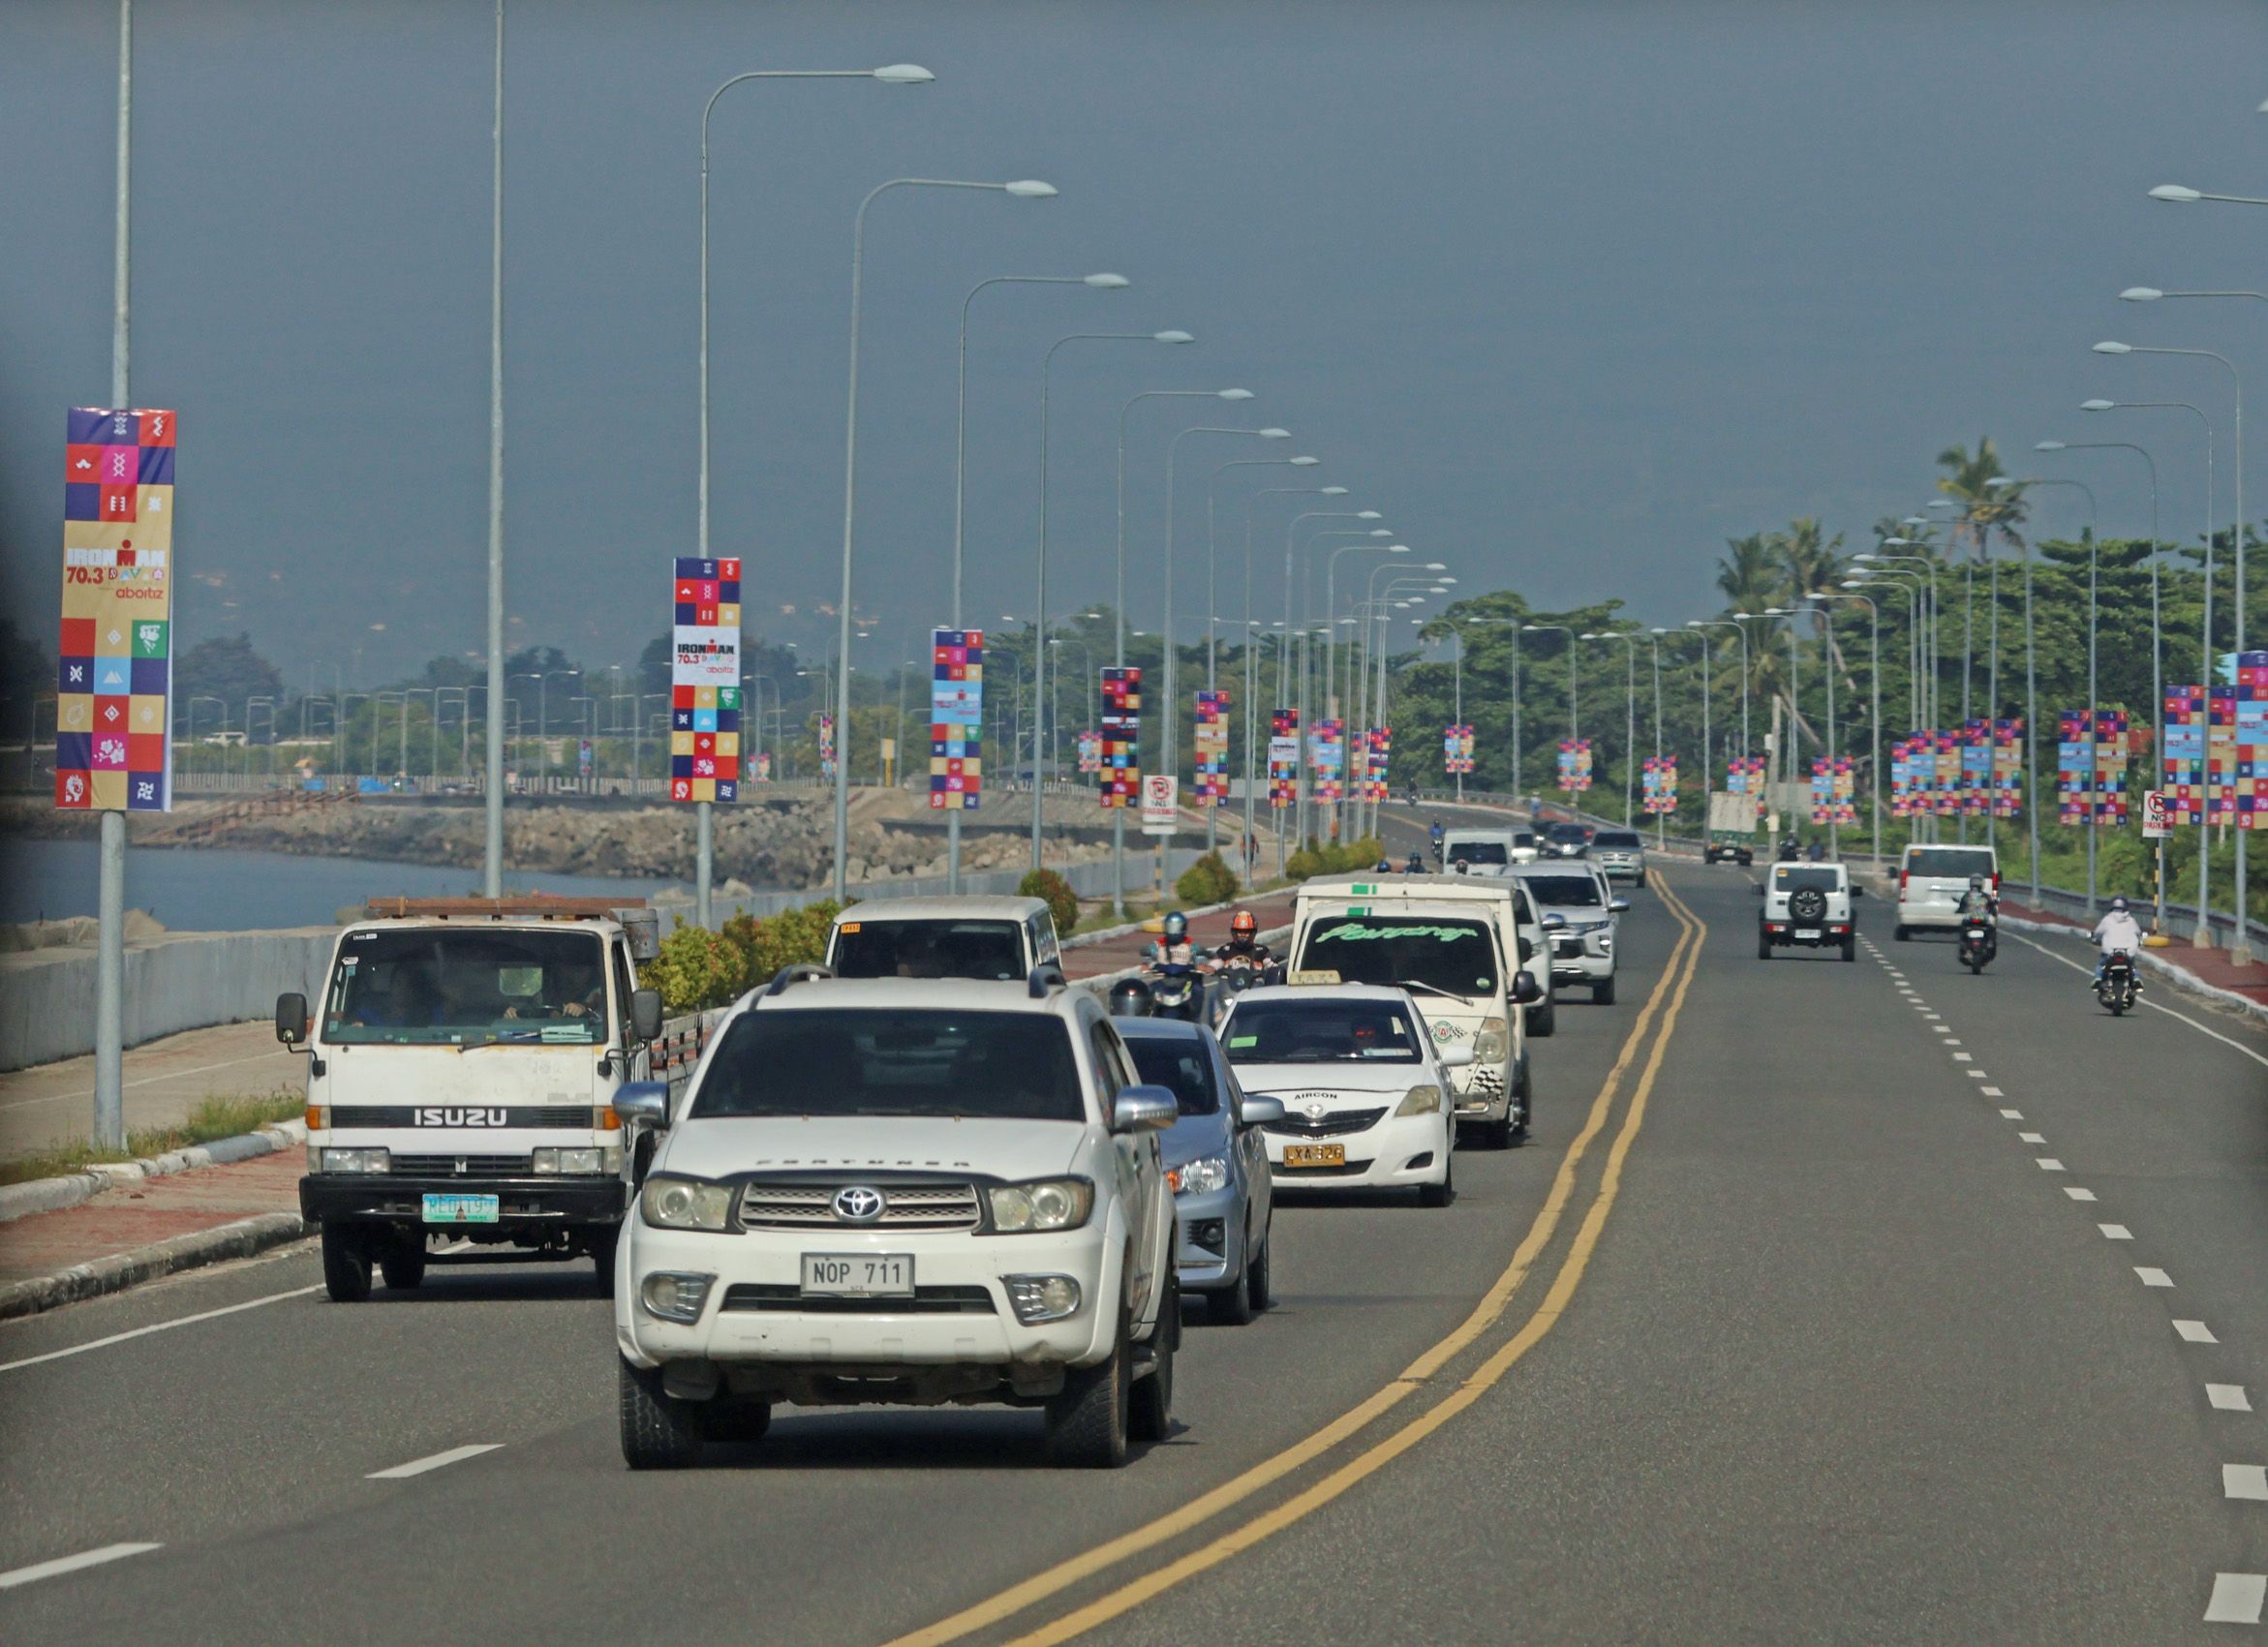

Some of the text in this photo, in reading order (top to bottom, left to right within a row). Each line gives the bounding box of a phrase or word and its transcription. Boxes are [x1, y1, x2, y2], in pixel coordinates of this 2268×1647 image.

[67, 539, 165, 566] IRONMAN
[67, 566, 104, 584] 70.3
[678, 639, 734, 655] IRONMAN
[678, 654, 699, 664] 70.3
[2151, 813, 2166, 822] NO
[414, 1108, 506, 1126] ISUZU
[813, 1262, 901, 1285] NOP 711
